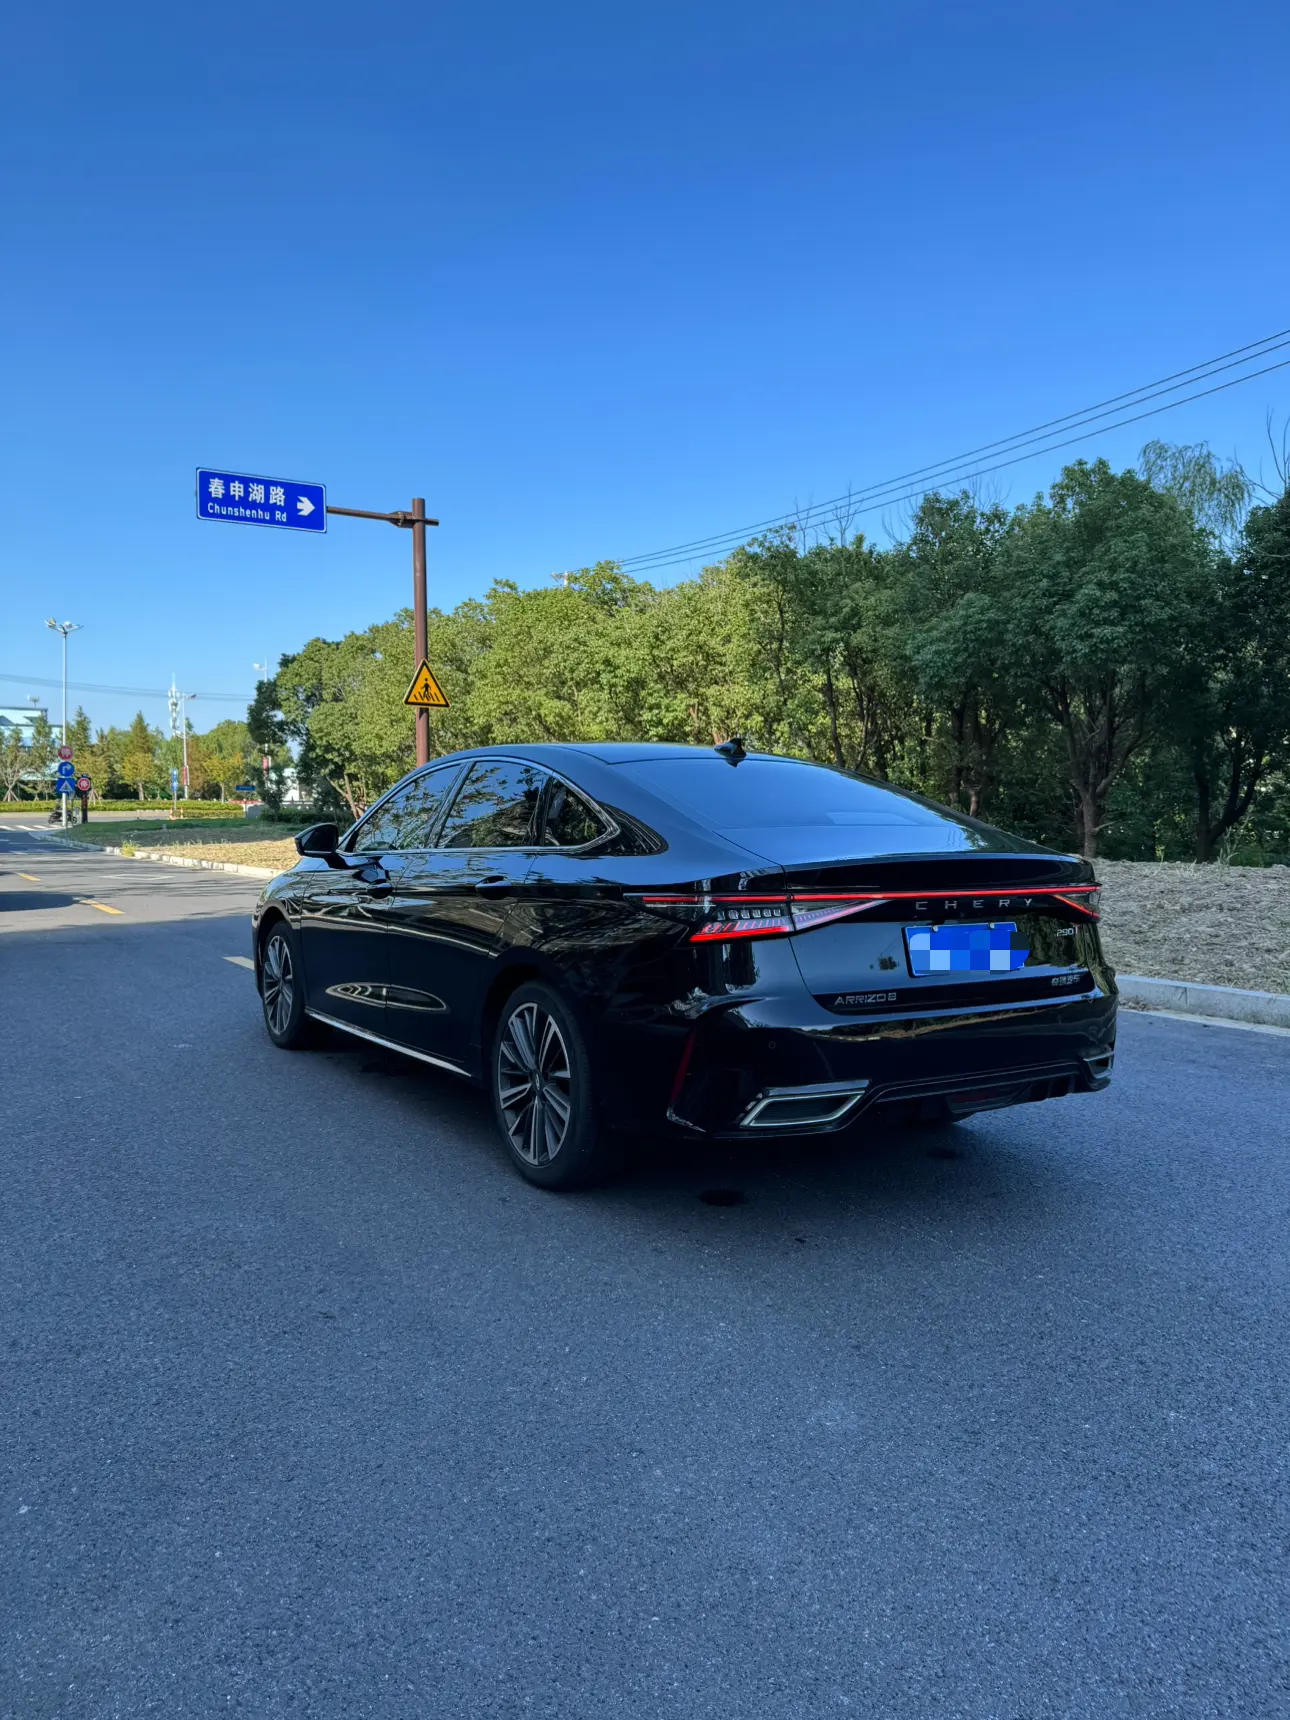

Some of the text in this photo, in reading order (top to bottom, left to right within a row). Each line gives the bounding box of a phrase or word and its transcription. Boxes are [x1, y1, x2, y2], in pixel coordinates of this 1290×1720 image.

[208, 478, 285, 506] 春申湖路
[207, 502, 287, 522] Chunshenhu Rd
[915, 898, 1032, 910] CHERY
